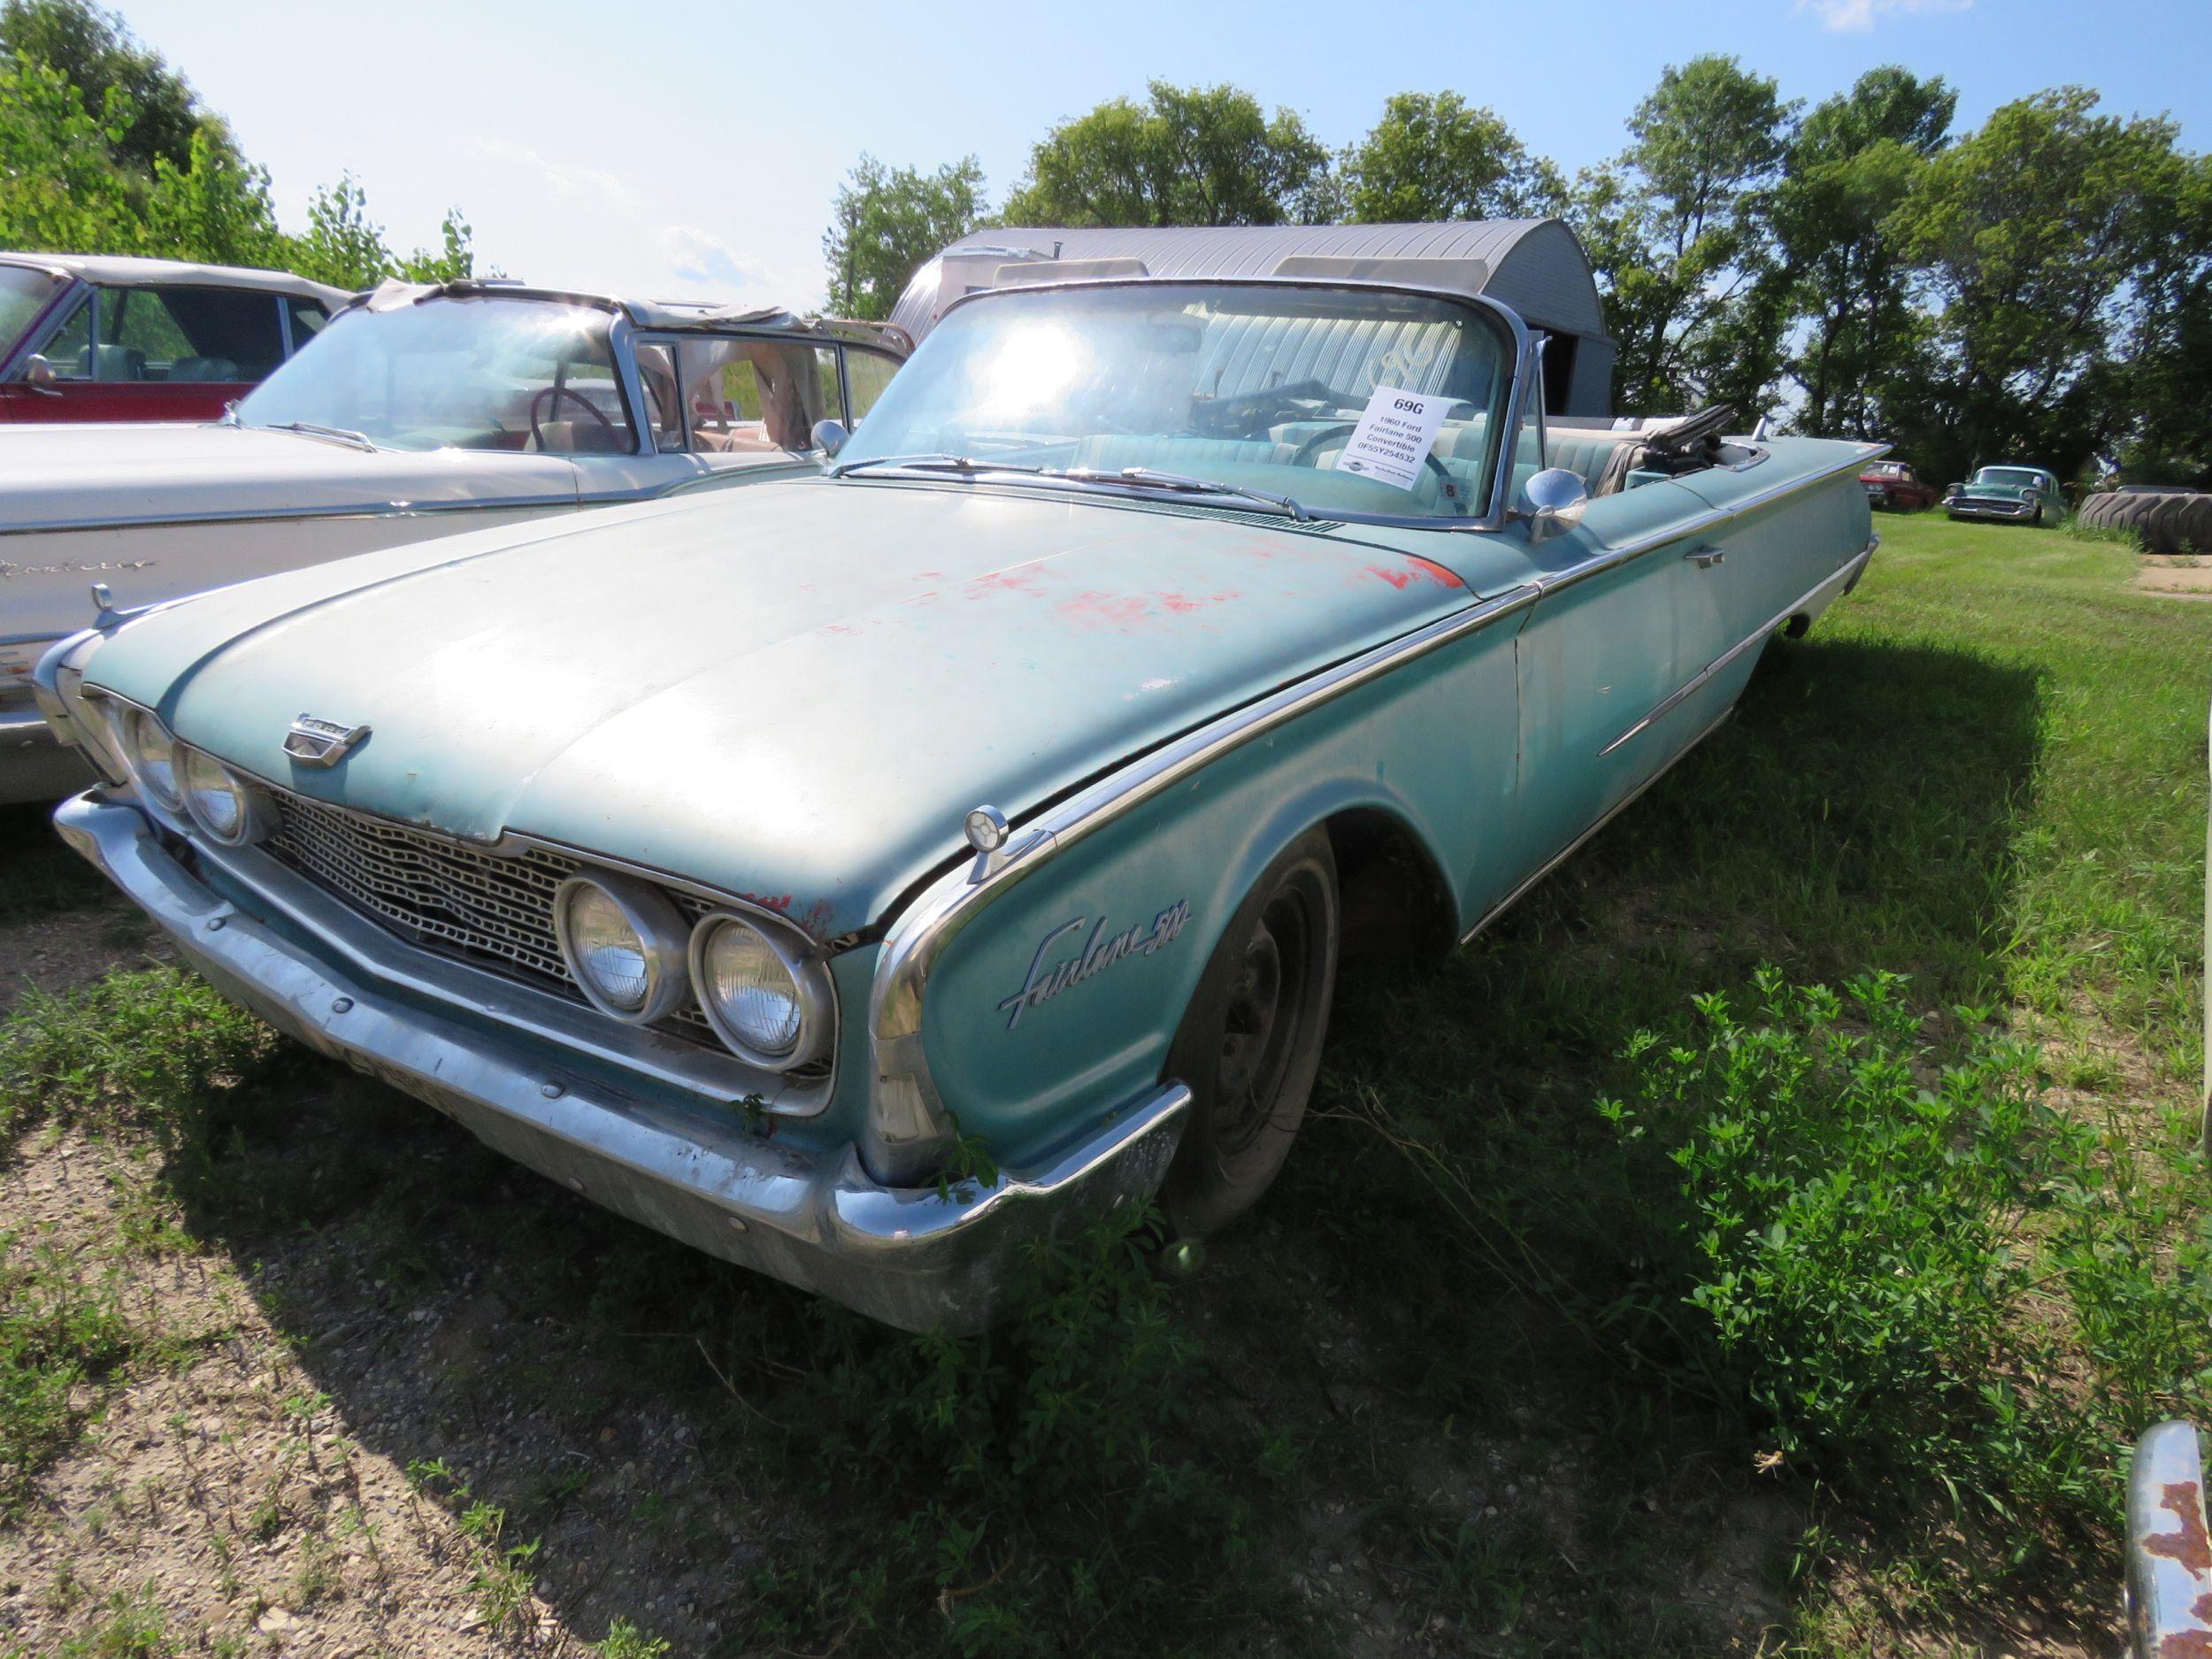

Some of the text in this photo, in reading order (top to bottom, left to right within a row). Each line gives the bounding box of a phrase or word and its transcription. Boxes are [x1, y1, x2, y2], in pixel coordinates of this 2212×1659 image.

[1394, 398, 1425, 415] 69G
[1368, 424, 1422, 444] Fairlane 500
[1379, 416, 1422, 433] 1960 Ford
[1366, 434, 1416, 453] Convertible
[996, 898, 1194, 1030] Fairlane 500
